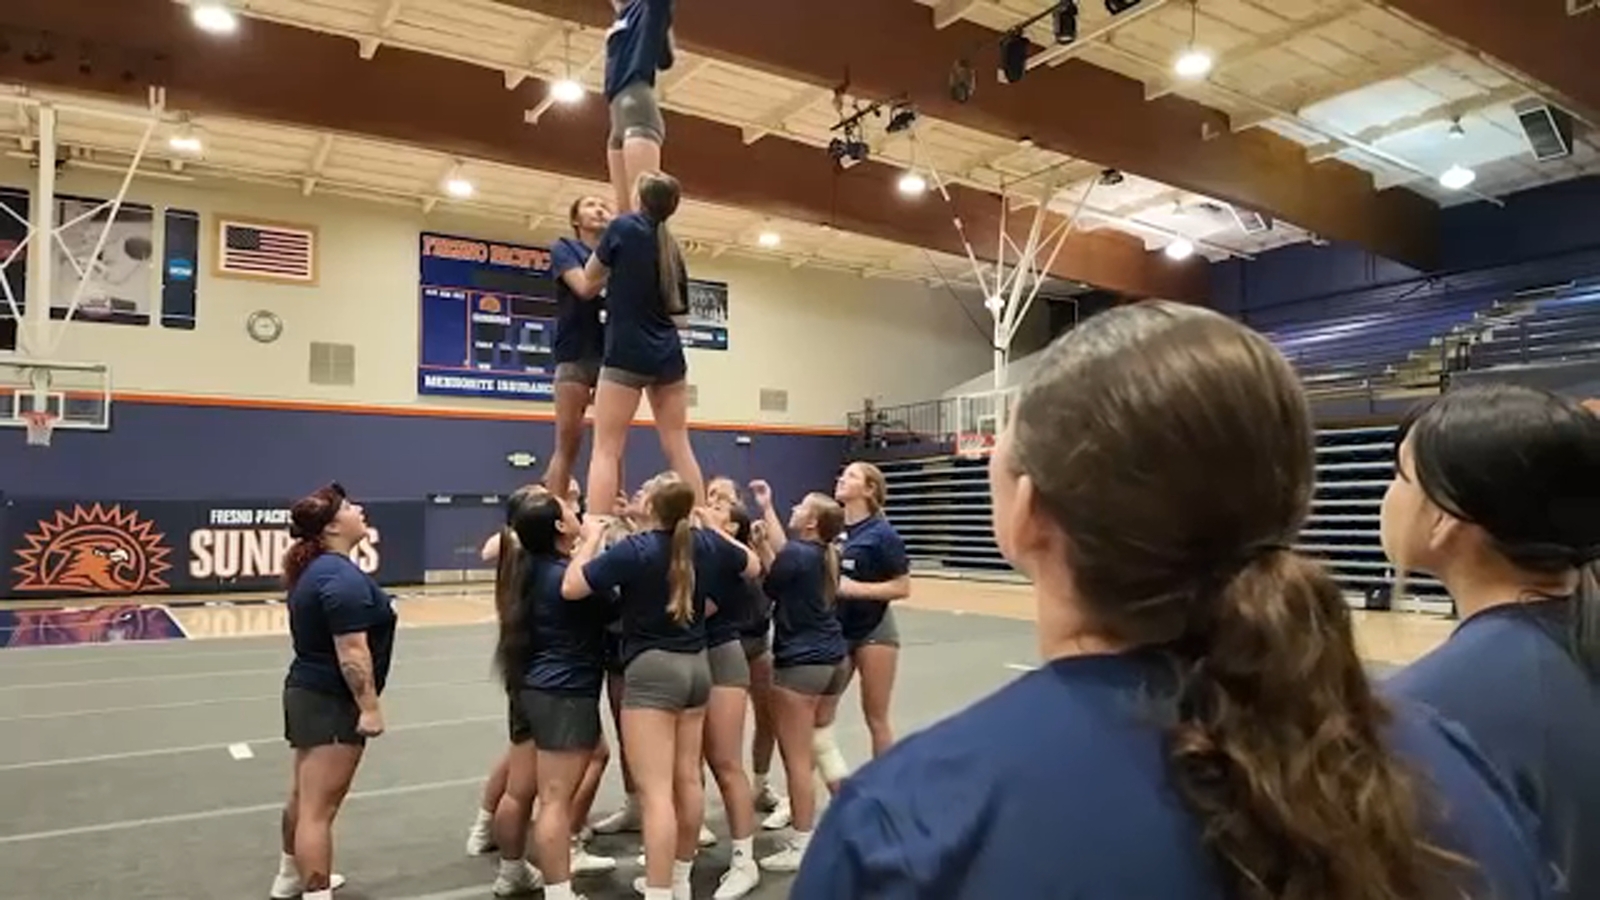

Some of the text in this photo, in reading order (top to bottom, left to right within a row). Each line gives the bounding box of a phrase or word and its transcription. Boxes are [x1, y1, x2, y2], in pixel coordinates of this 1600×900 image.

[497, 380, 555, 394] INSURANC
[210, 509, 293, 524] FRESNO PACIFI
